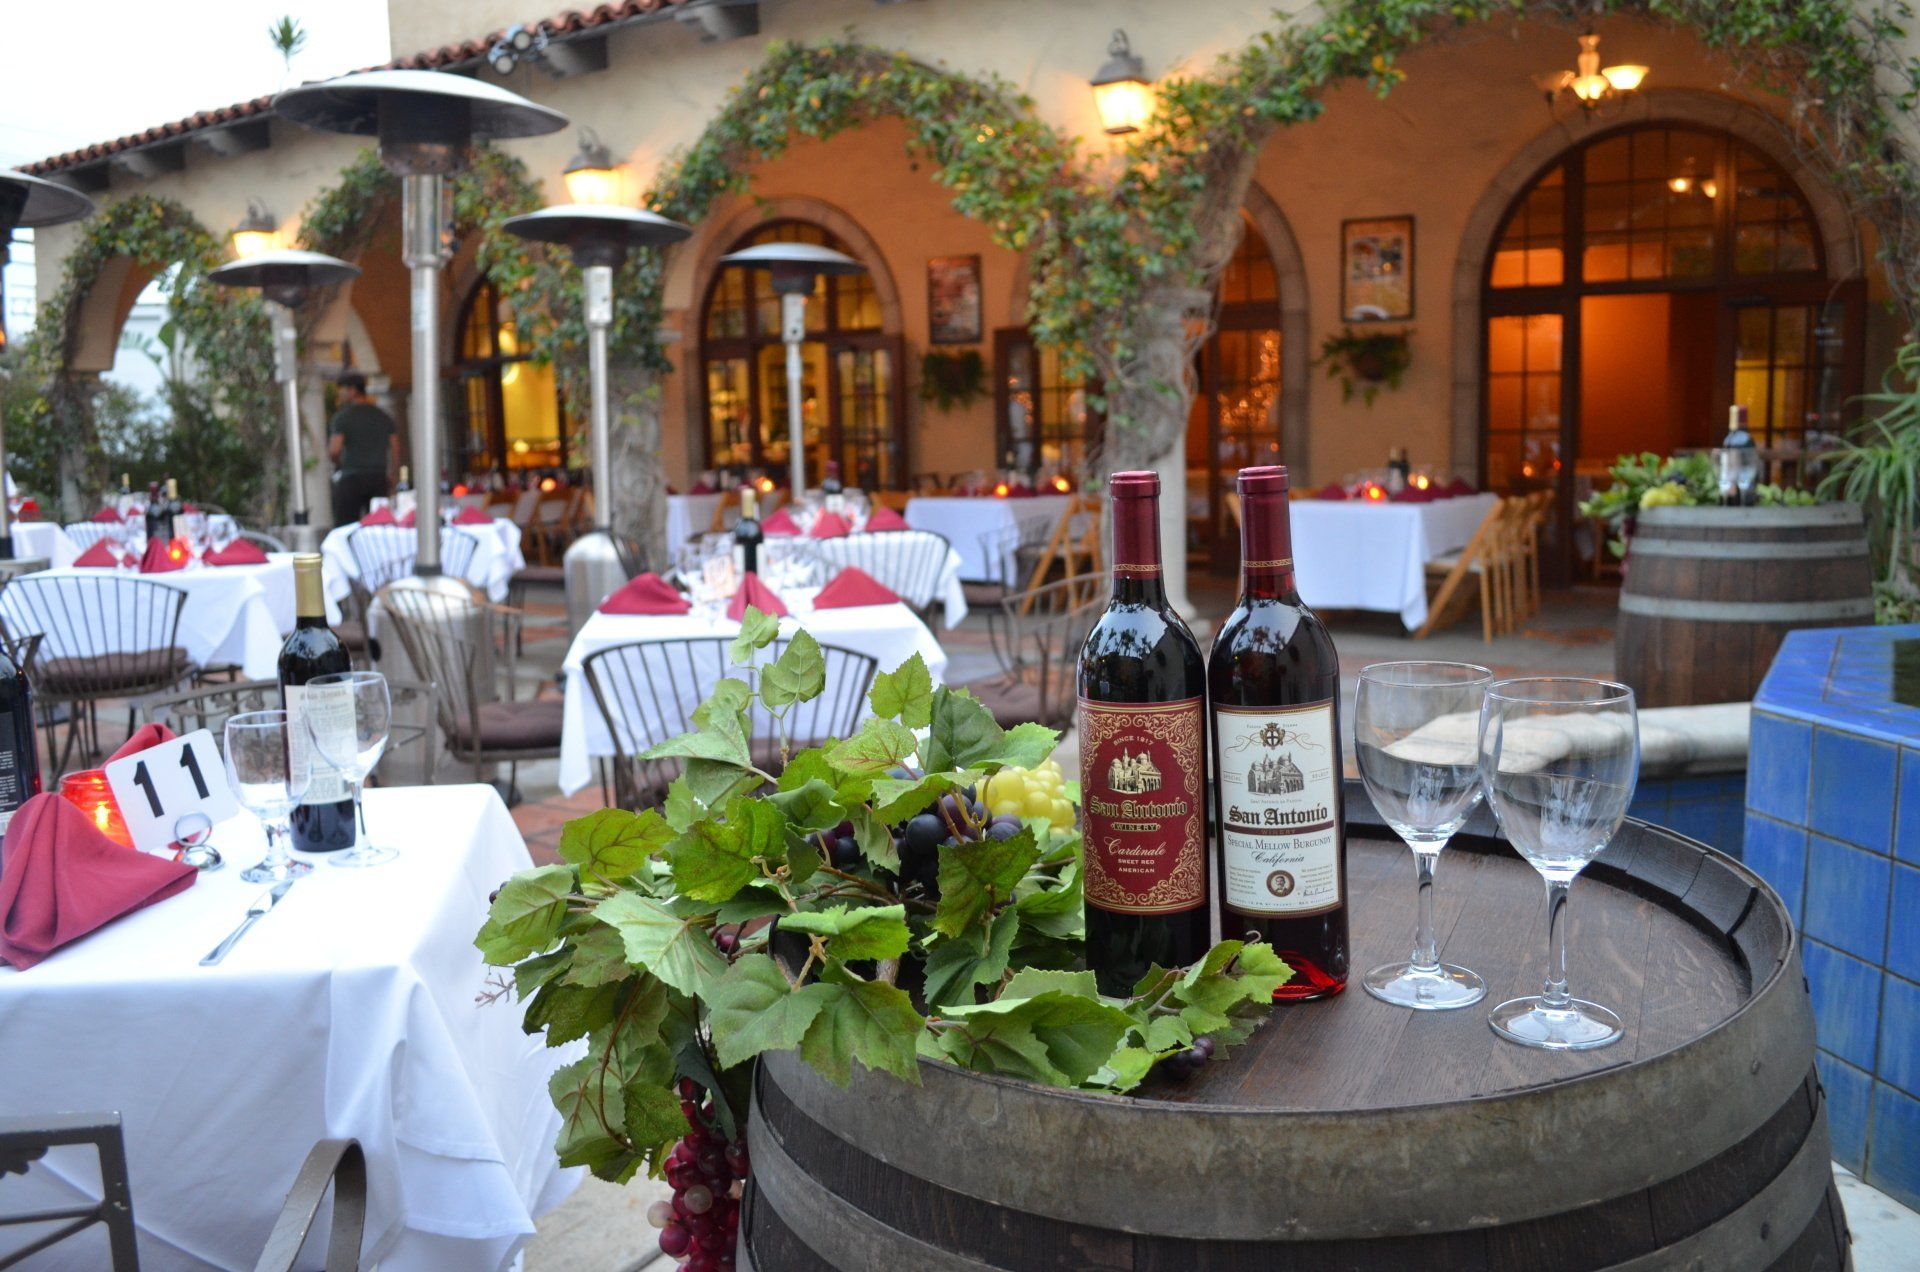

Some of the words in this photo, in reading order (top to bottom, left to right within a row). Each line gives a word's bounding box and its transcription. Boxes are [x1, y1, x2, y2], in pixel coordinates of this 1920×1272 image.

[1113, 735, 1134, 746] SINCE
[1137, 735, 1154, 746] 1917
[133, 742, 210, 818] 11
[1090, 795, 1119, 817] San
[1121, 796, 1188, 819] Antonio
[1229, 804, 1261, 826] San
[1264, 802, 1328, 826] Antonio
[1116, 823, 1155, 831] WINERY
[1103, 836, 1167, 856] Cardinale
[1250, 851, 1305, 867] California
